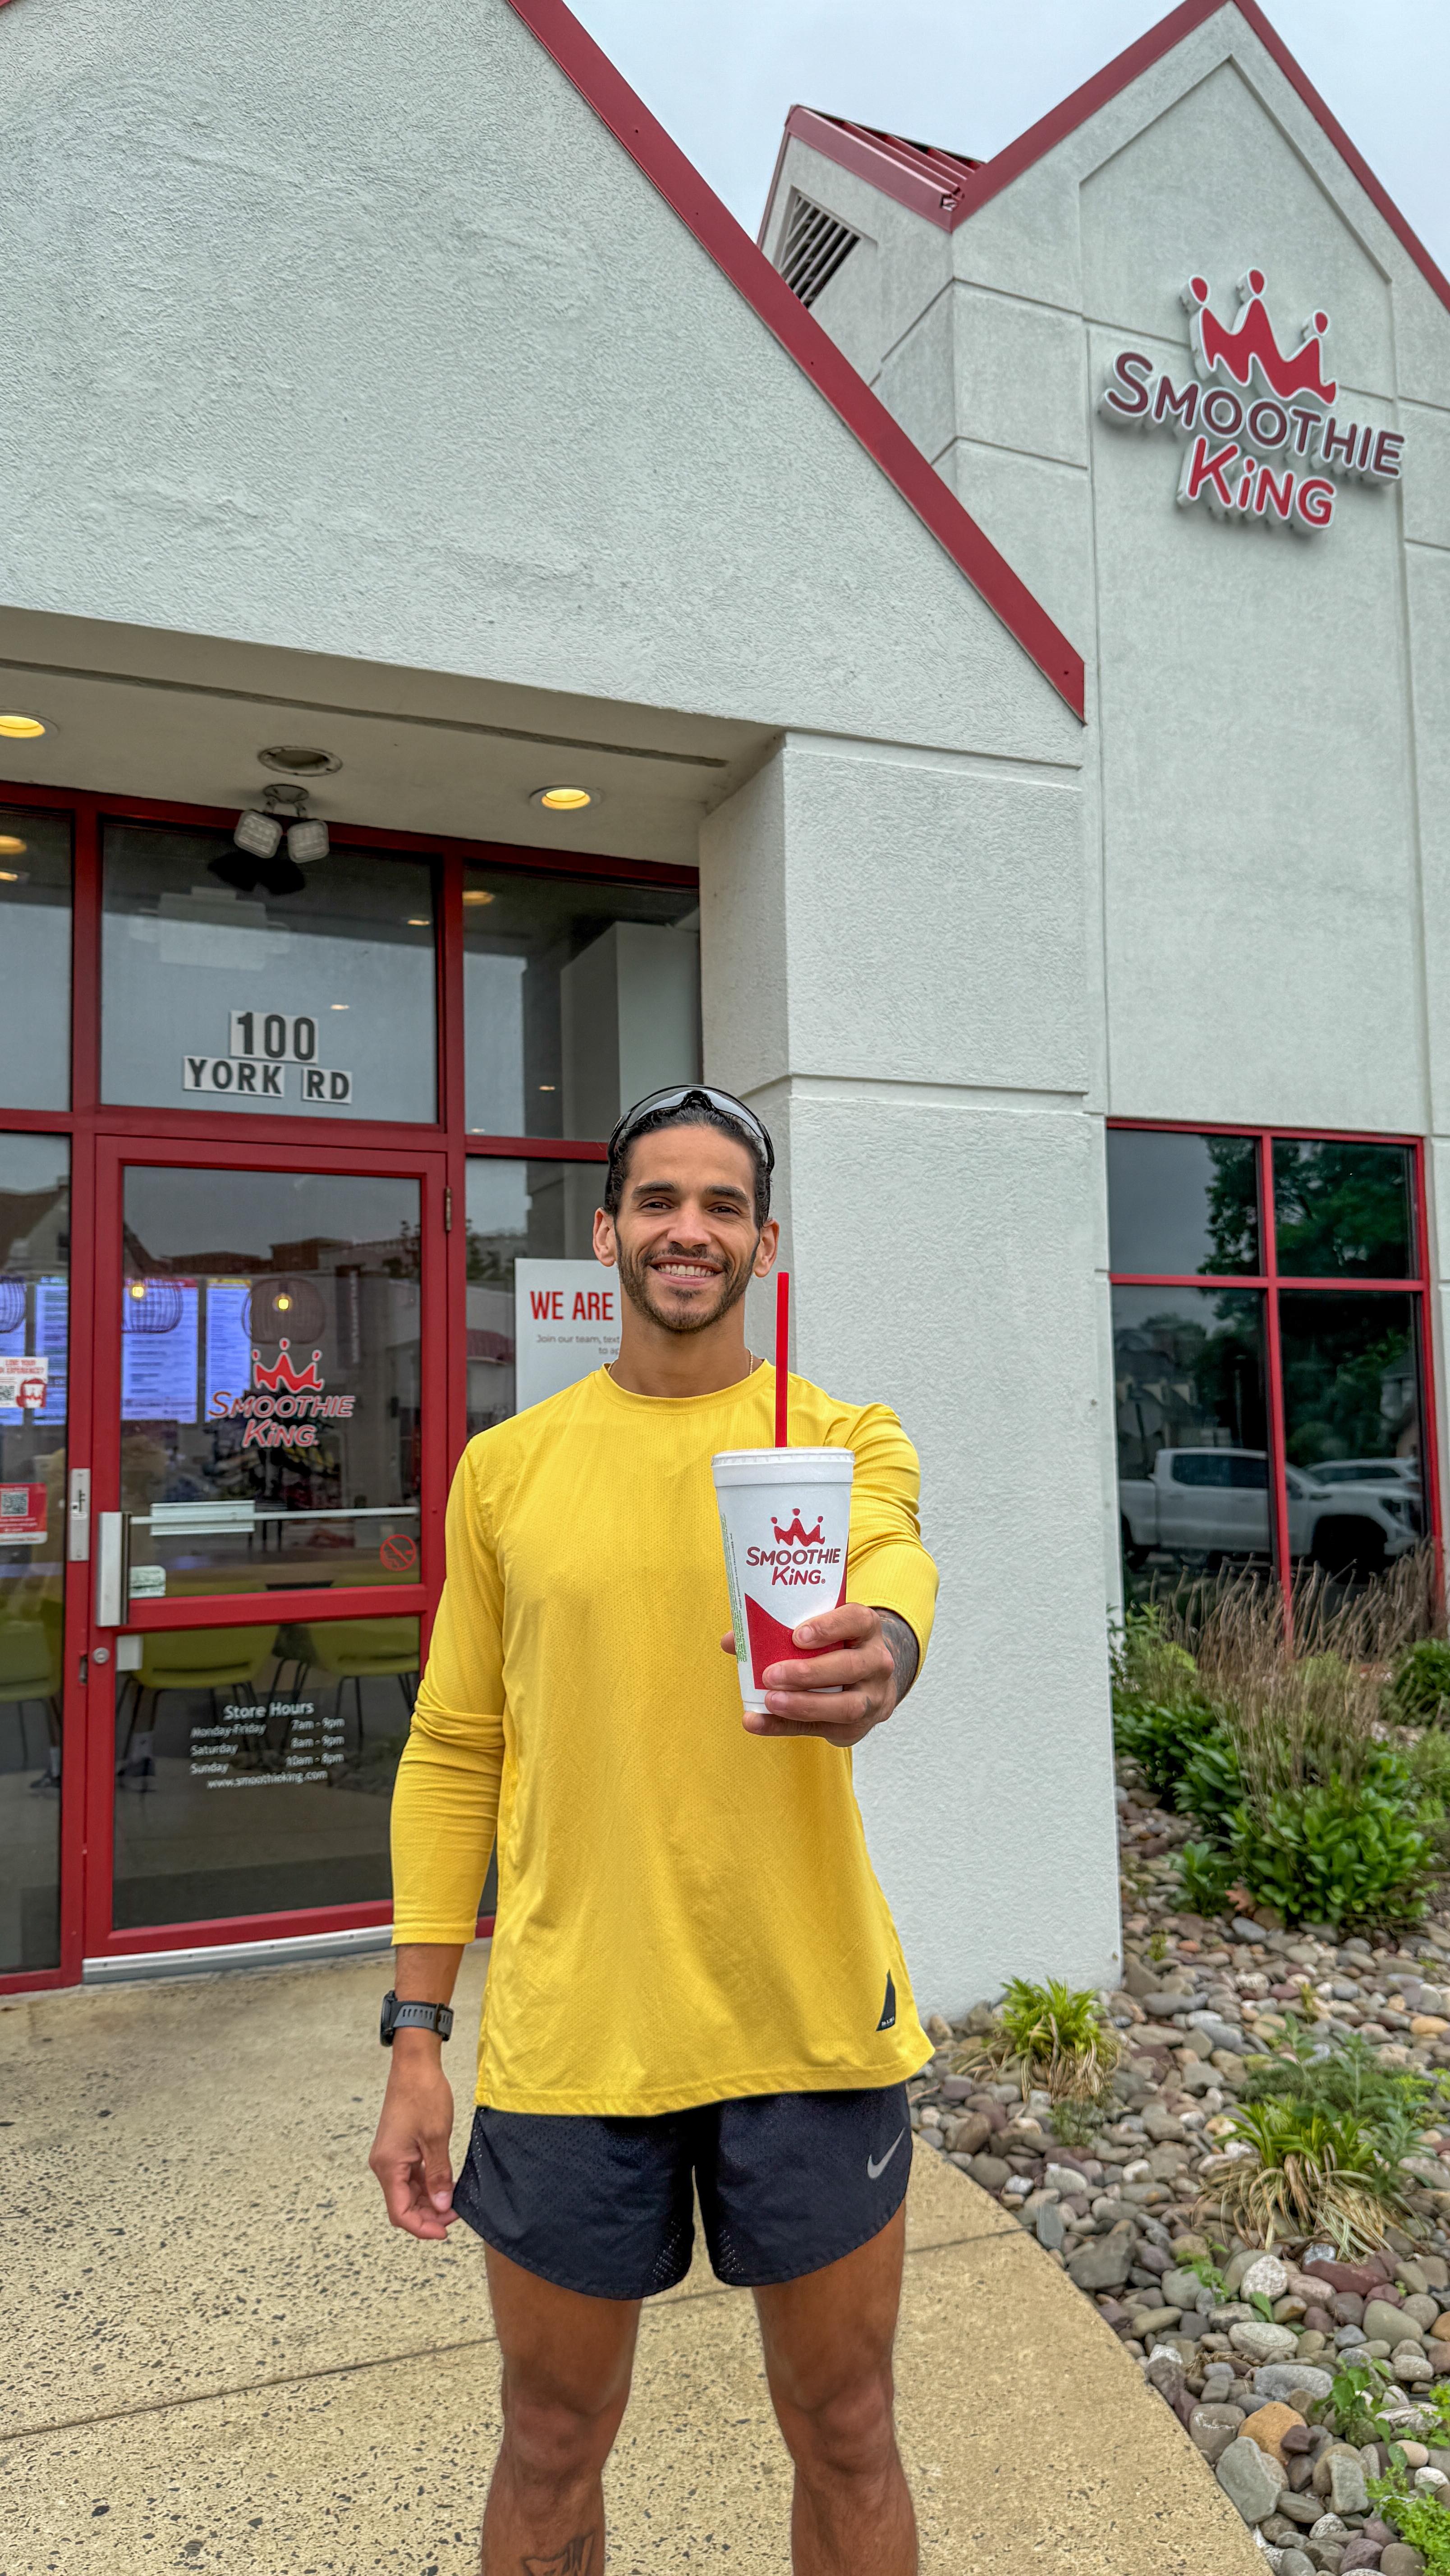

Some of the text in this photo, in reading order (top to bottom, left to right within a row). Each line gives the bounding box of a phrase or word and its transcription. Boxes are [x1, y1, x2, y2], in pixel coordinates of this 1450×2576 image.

[1105, 351, 1404, 479] SMOOTHIE
[237, 1012, 315, 1060] 100
[187, 1058, 349, 1099] YORK RD
[530, 1291, 614, 1320] WE ARE
[209, 1392, 355, 1417] SMOOTHIE
[746, 1546, 840, 1566] SMOOTHIE
[223, 1702, 314, 1720] Store Hours
[190, 1723, 266, 1739] Monday-Friday
[290, 1719, 314, 1731] 7am
[190, 1744, 239, 1757] Saturday
[189, 1762, 229, 1776] Sunday
[206, 1770, 328, 1789] www.smoothieking.com
